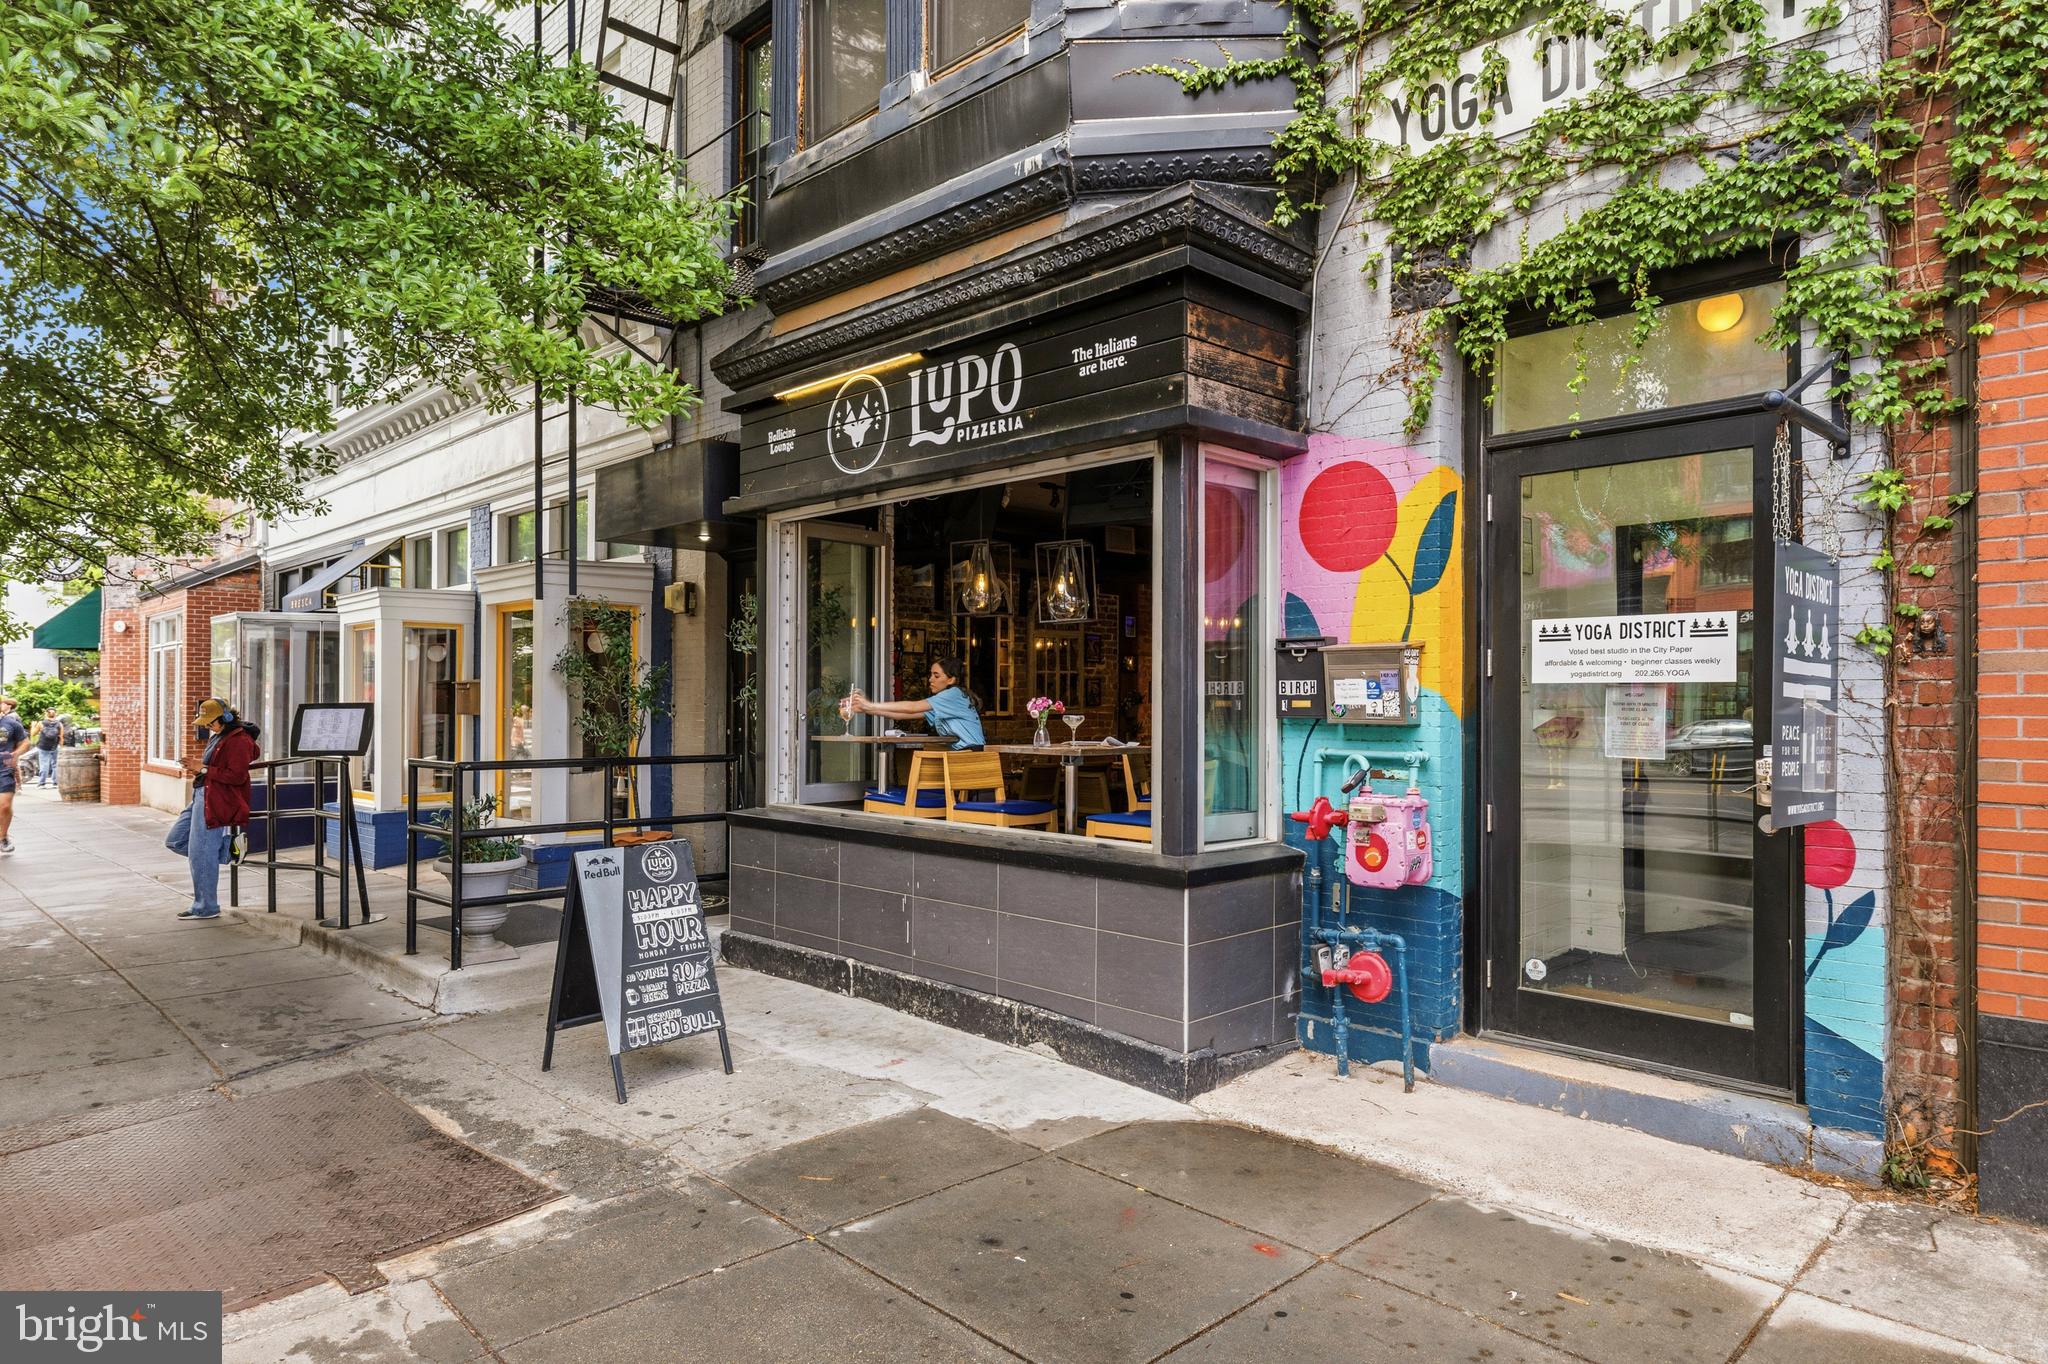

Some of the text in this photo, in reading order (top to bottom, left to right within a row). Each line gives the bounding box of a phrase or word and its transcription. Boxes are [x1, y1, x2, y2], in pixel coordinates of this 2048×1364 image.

[1391, 62, 1513, 146] YOGA
[1072, 335, 1138, 363] The Italians
[1079, 355, 1128, 377] are here.
[908, 342, 1022, 447] LUPO
[957, 415, 1024, 442] PIZZERIA
[770, 441, 795, 455] Lounge
[1785, 566, 1833, 606] YOGA DISTRICT
[1575, 619, 1686, 641] YOGA DISTRICT
[1653, 646, 1668, 654] City
[1669, 645, 1693, 654] Paper
[1544, 659, 1577, 667] affordable
[1586, 659, 1623, 667] welcoming
[1630, 658, 1662, 667] beginner
[1694, 657, 1721, 665] weekly
[1570, 670, 1622, 678] yogadistrict.org
[1280, 681, 1316, 694] BIRCH
[1781, 725, 1800, 741] PEACE
[1781, 761, 1800, 776] PEOPLE
[584, 866, 621, 880] Red Bull
[647, 856, 672, 872] LUPO
[627, 882, 697, 912] HAPPY
[634, 916, 705, 950] HOUR
[639, 948, 668, 960] MONDAY
[680, 941, 706, 953] FRIDAY
[635, 965, 664, 982] WINE
[675, 977, 711, 996] PIZZA
[649, 1010, 722, 1042] RED BULL
